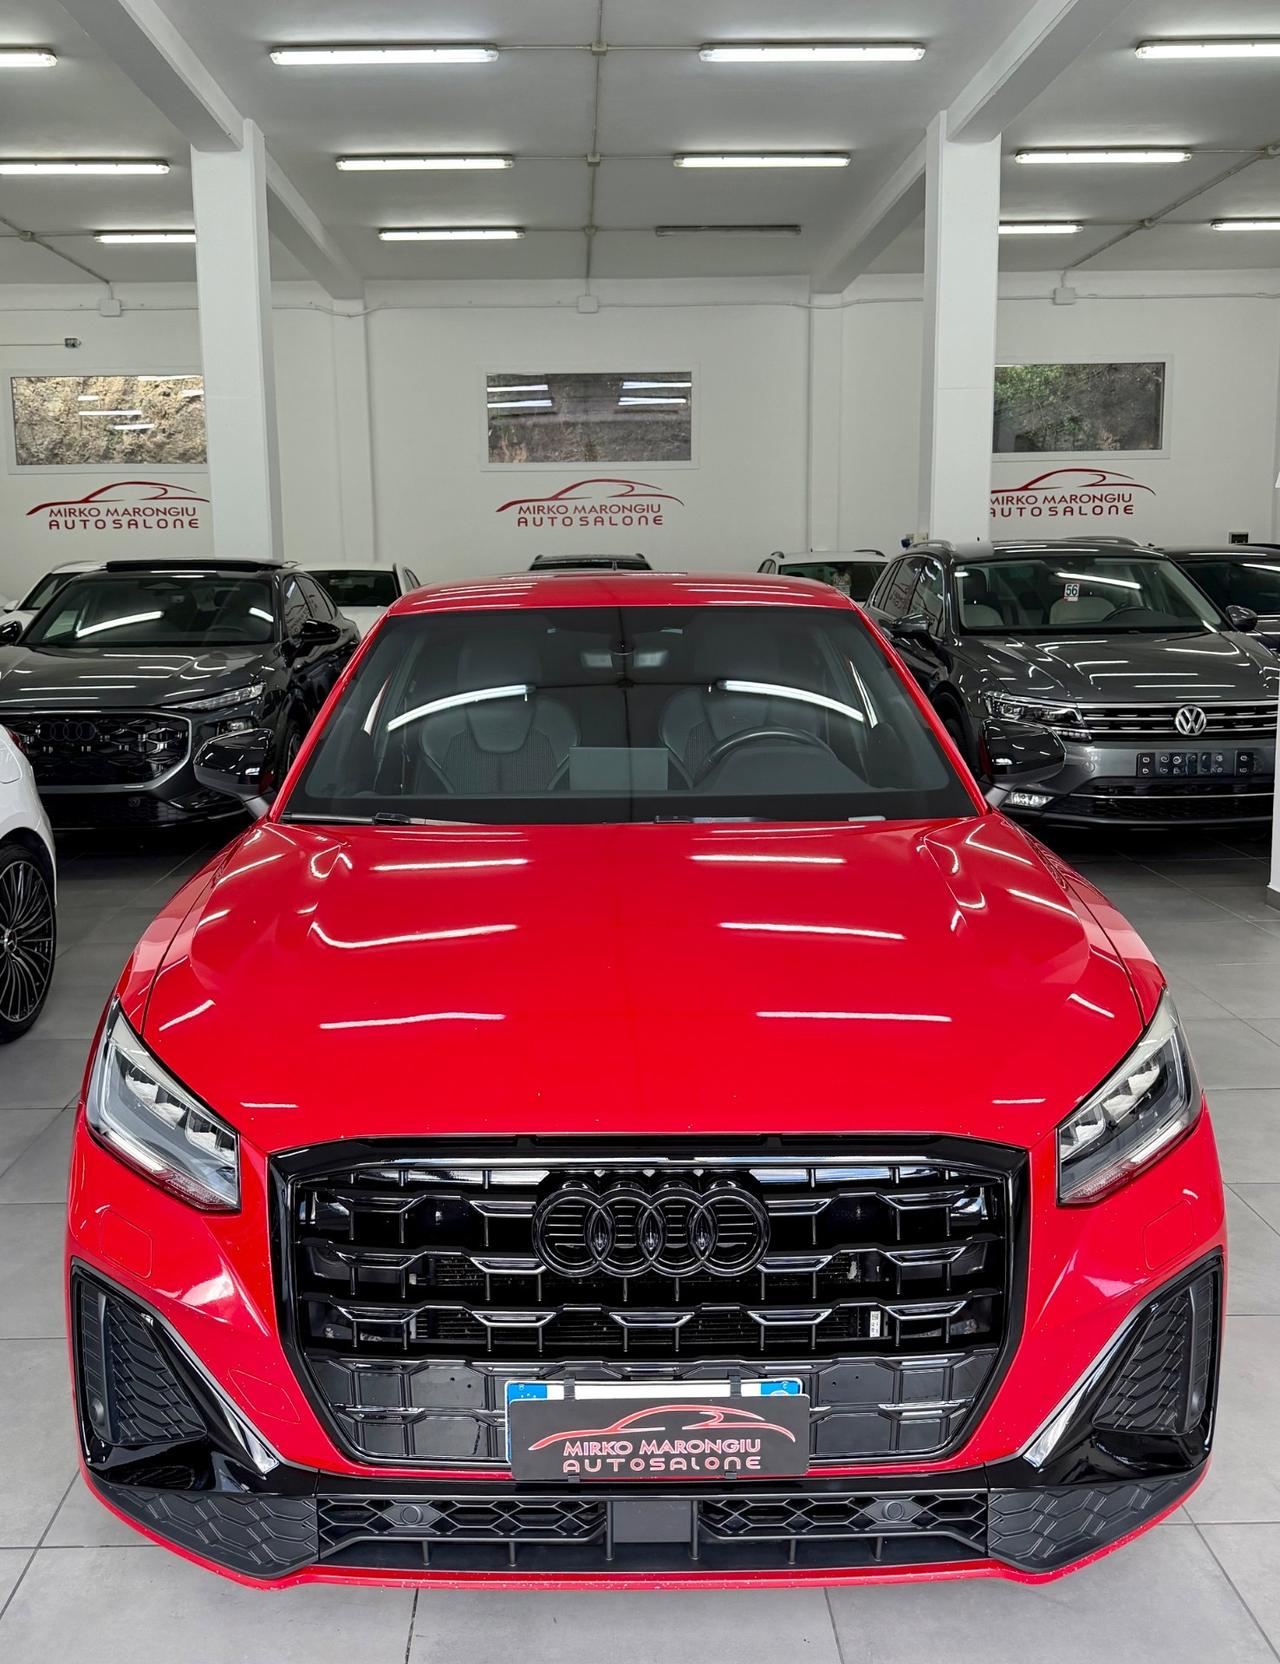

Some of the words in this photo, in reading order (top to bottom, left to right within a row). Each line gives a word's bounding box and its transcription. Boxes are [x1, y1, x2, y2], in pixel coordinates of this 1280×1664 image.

[990, 495, 1037, 505] MIRKO
[1042, 493, 1133, 505] MARONGIU
[49, 507, 101, 518] MIRKO
[105, 506, 197, 518] MARONGIU
[518, 504, 569, 515] MIRKO
[573, 503, 662, 515] MARONGIU
[48, 518, 200, 531] AUTOSALONE
[517, 515, 664, 528] AUTOSALONE
[1066, 584, 1078, 596] 56
[563, 1440, 632, 1456] MIRKO
[638, 1438, 761, 1456] MARONGIU
[562, 1456, 762, 1473] AUTOSALONE
